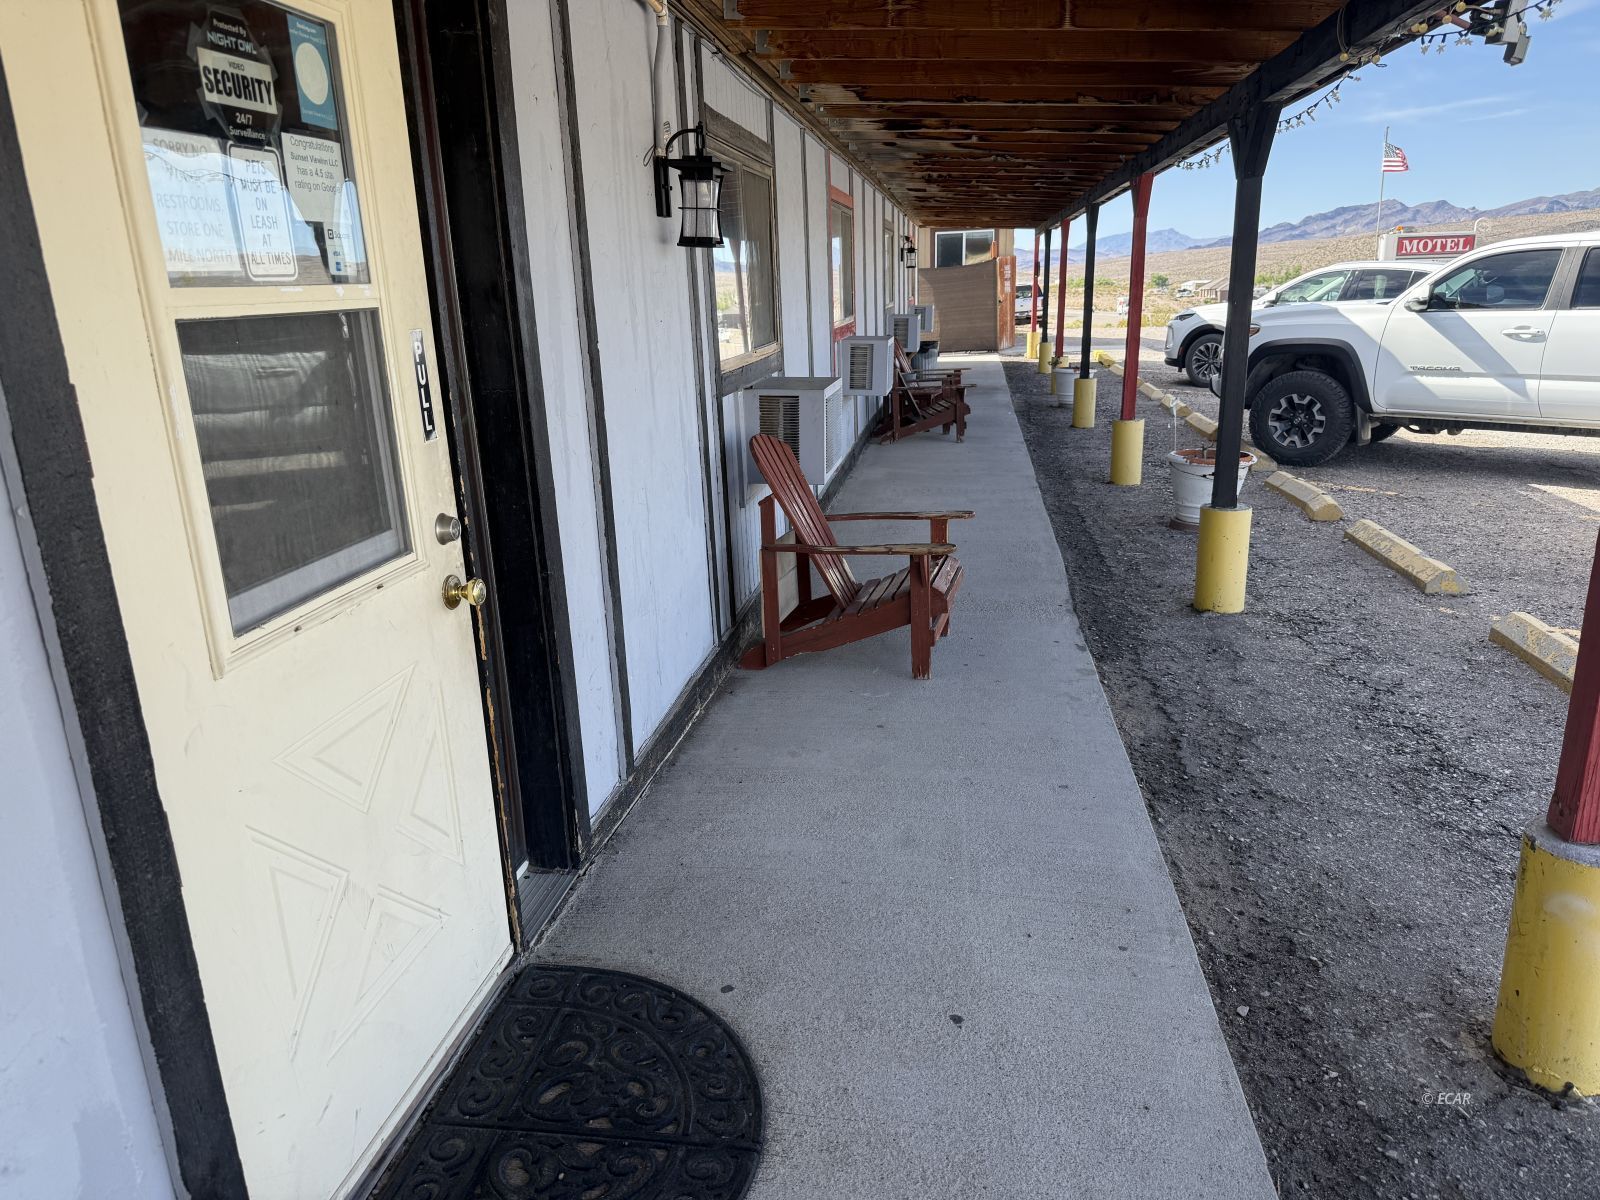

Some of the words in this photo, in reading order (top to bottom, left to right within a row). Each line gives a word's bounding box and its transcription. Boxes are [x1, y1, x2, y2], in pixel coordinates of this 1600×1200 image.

[213, 18, 239, 33] Protected
[239, 27, 247, 38] By
[207, 30, 237, 49] NIGHT
[237, 40, 257, 55] OWL
[228, 61, 245, 72] VIDEO
[202, 65, 273, 106] SECURITY
[235, 112, 253, 126] 24/7
[229, 126, 266, 140] Surveillance
[245, 159, 266, 175] PETS
[297, 165, 309, 176] has
[240, 179, 263, 193] MUST
[264, 181, 277, 194] BE
[295, 180, 312, 192] rating
[312, 183, 321, 191] on
[255, 197, 268, 212] ON
[166, 220, 202, 237] STORE
[202, 222, 224, 238] ONE
[250, 215, 279, 230] LEASH
[262, 233, 272, 247] AT
[1401, 237, 1470, 254] MOTEL
[250, 250, 266, 265] ALL
[265, 252, 292, 265] TIMES
[413, 341, 433, 431] PULL
